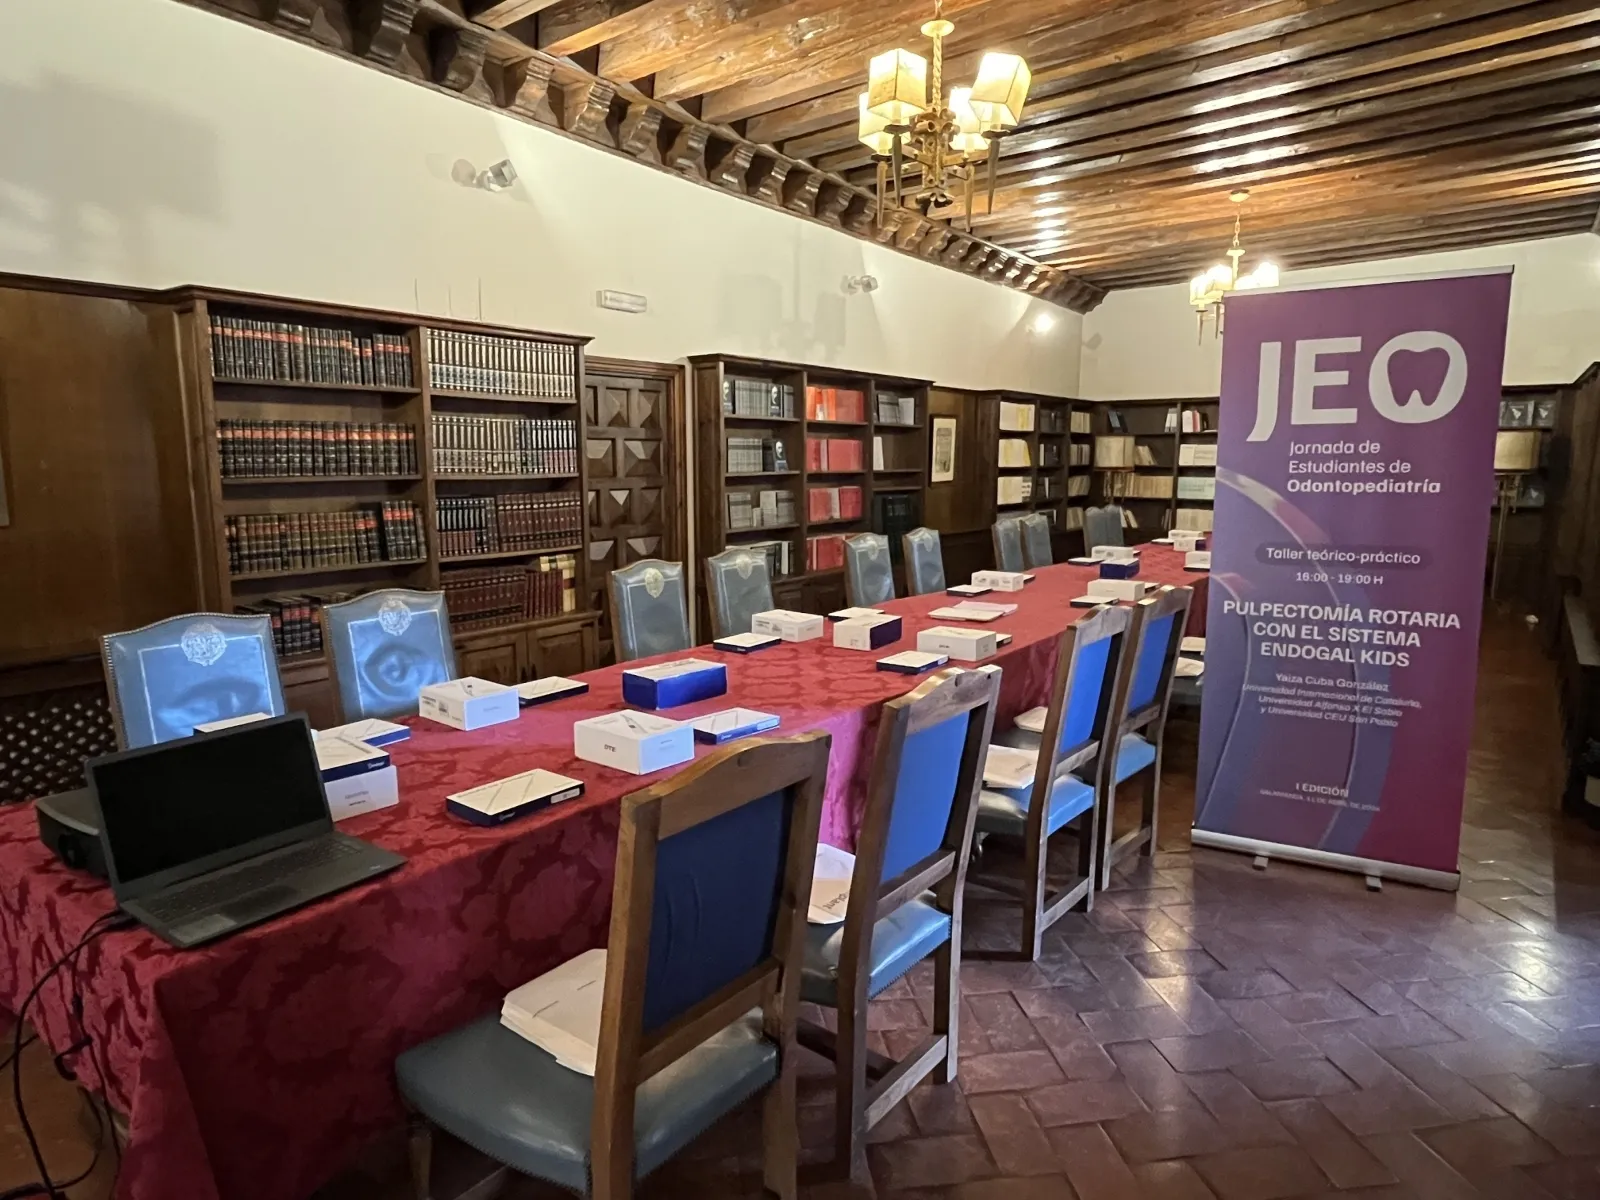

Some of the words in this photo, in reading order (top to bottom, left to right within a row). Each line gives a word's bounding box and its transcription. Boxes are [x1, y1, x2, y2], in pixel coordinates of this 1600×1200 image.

[1246, 331, 1468, 442] JEO
[1289, 440, 1354, 457] Jornada
[1358, 440, 1381, 454] de
[1288, 460, 1385, 475] Estudiantes
[1389, 460, 1412, 474] de
[1287, 478, 1441, 495] Odontopediatría
[1266, 547, 1304, 560] Taller
[1307, 547, 1421, 565] teórico-práctico
[1295, 571, 1329, 583] 16:00
[1337, 573, 1371, 585] 19:00
[1373, 575, 1384, 585] H
[1223, 600, 1363, 622] PULPECTOMÍA
[1368, 609, 1461, 629] ROTARIA
[1253, 622, 1296, 638] CON
[1300, 625, 1324, 640] EL
[1328, 627, 1421, 648] SISTEMA
[1260, 642, 1356, 663] ENDOGAL
[1360, 650, 1410, 667] KIDS
[1275, 673, 1303, 683] Yaiza
[1305, 676, 1334, 686] Cuba
[1336, 678, 1389, 692] González
[1302, 783, 1349, 797] EDICIÓN
